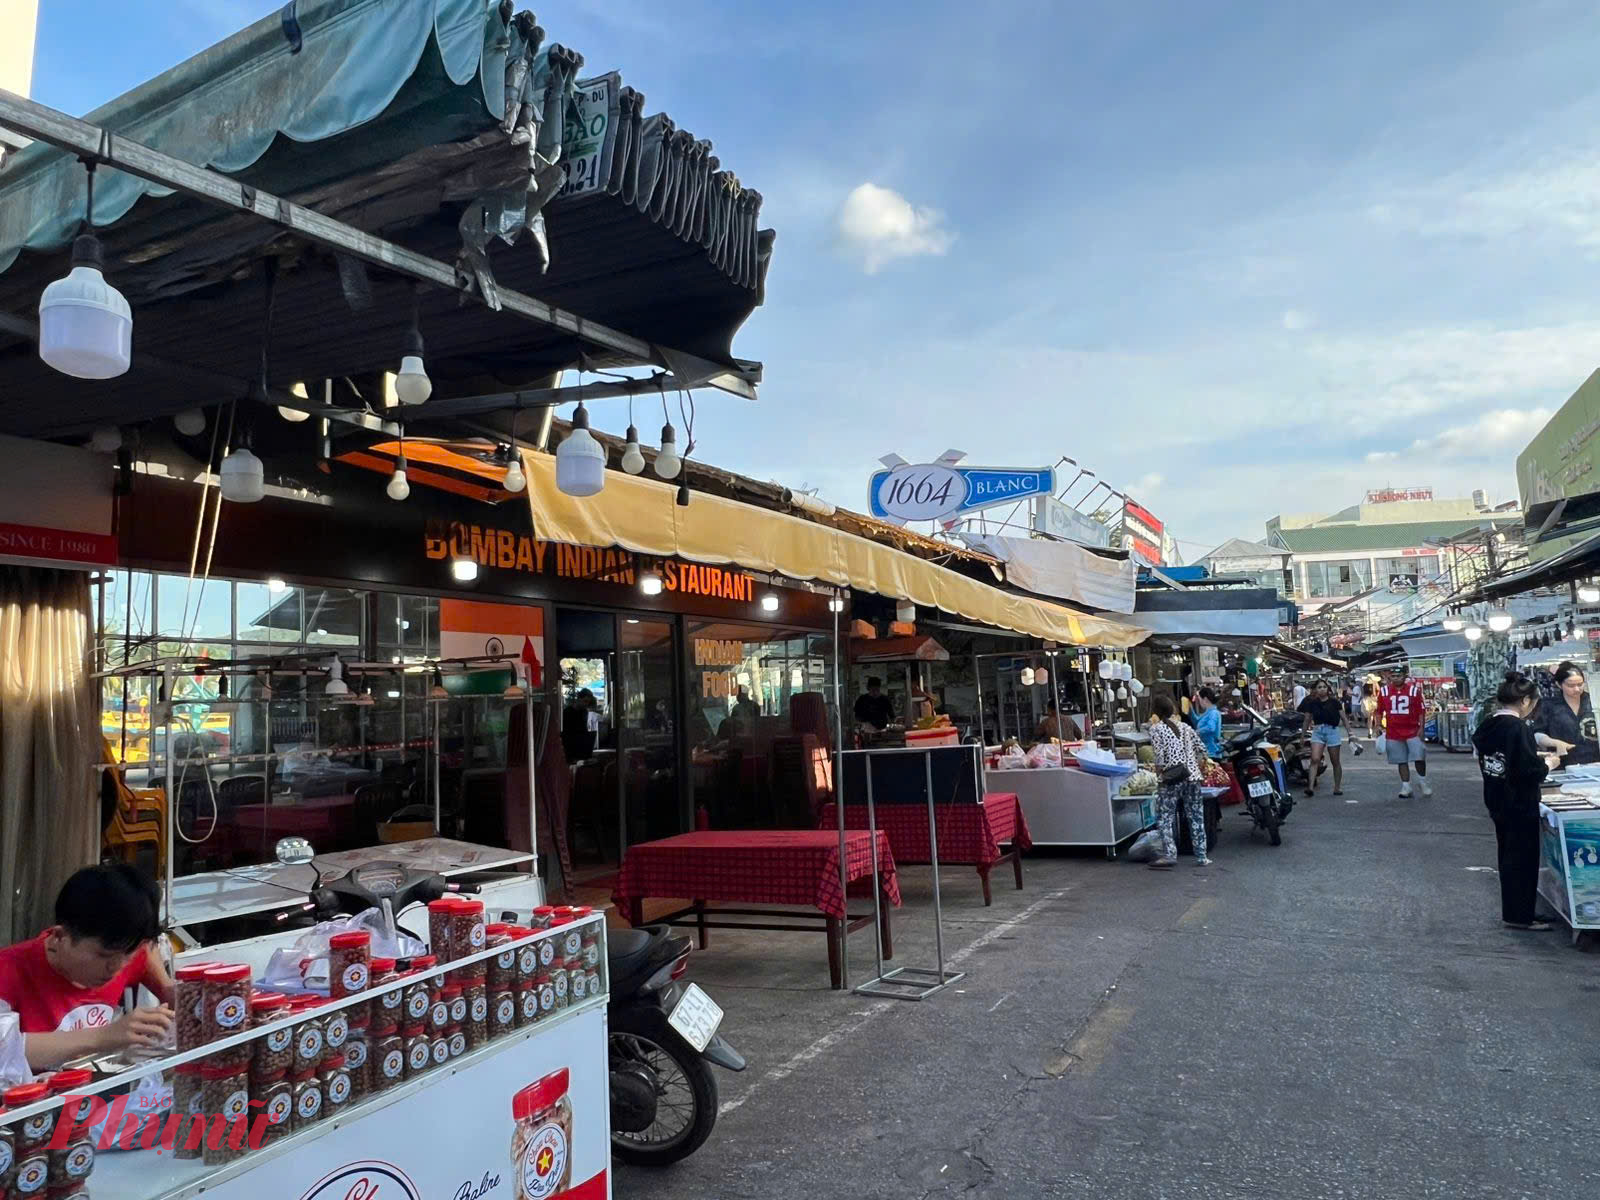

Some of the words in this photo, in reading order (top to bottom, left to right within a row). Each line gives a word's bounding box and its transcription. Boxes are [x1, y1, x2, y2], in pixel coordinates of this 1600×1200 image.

[593, 88, 604, 103] DU
[887, 472, 954, 506] 1664
[976, 476, 1033, 494] BLANC
[556, 541, 635, 585] INDIAN
[695, 639, 743, 666] INDIAN
[703, 672, 739, 698] FOOD
[1390, 695, 1410, 715] 12
